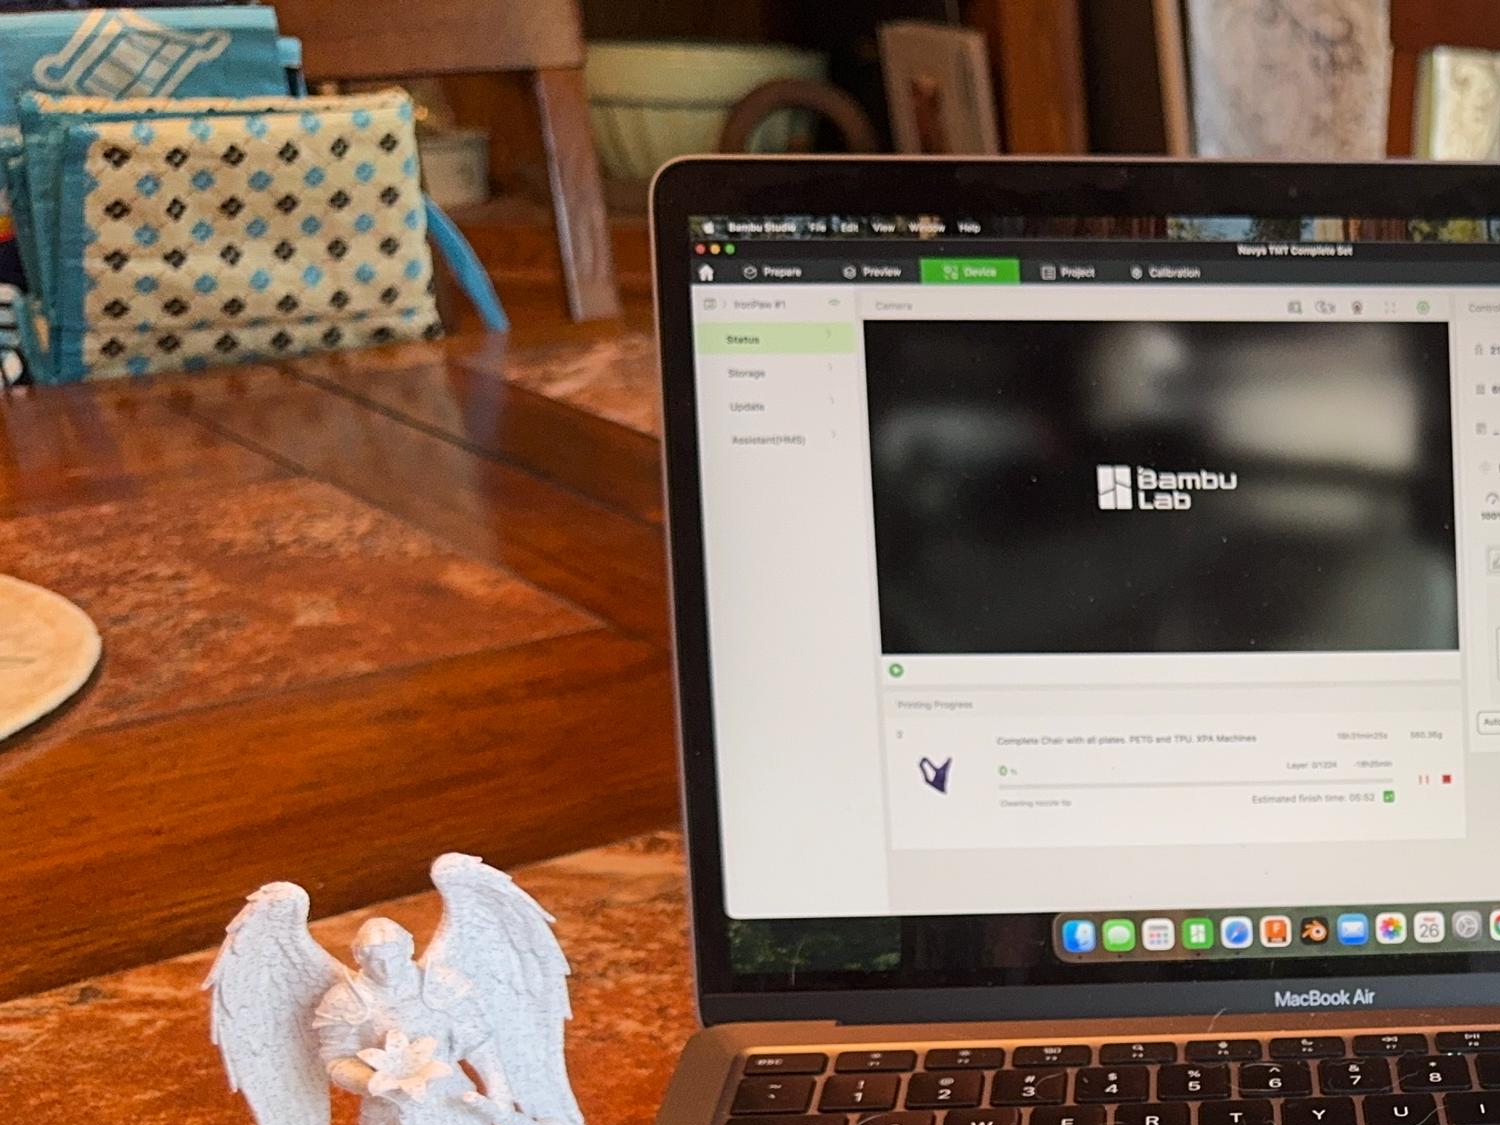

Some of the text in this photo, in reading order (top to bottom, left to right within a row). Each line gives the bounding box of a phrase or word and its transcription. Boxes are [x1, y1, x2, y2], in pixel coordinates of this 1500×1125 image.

[728, 222, 797, 233] Bambu Studio
[810, 222, 827, 233] File
[840, 222, 859, 233] Edit
[872, 222, 896, 233] View
[908, 222, 946, 233] Window
[957, 222, 982, 234] Help
[763, 266, 802, 278] Prepare
[863, 266, 902, 277] Preview
[963, 267, 997, 277] Device
[1060, 266, 1096, 278] Project
[1149, 267, 1201, 278] Calibration
[875, 302, 913, 310] Camera
[726, 336, 760, 344] Status
[728, 369, 766, 379] Storage
[730, 403, 765, 412] Update
[1137, 465, 1238, 490] Bambu
[1138, 490, 1192, 510] Lab
[898, 701, 973, 711] Printing Progress
[996, 737, 1039, 747] Complete
[1066, 736, 1085, 745] with
[1216, 734, 1257, 743] Machines
[1252, 794, 1297, 804] Estimated
[1299, 793, 1323, 803] finish
[1419, 923, 1440, 938] 26
[1274, 988, 1376, 1007] MacBook Air
[1269, 1078, 1281, 1087] 6
[1350, 1075, 1361, 1085] 7
[1429, 1073, 1441, 1082] 8
[1105, 1084, 1117, 1093] 4
[1189, 1081, 1200, 1091] 5
[855, 1092, 862, 1101] 1
[938, 1089, 951, 1099] 2
[1023, 1087, 1035, 1096] 3
[1394, 1107, 1408, 1116] U
[1480, 1104, 1485, 1113] I
[1230, 1113, 1242, 1123] T
[1312, 1110, 1325, 1120] Y
[1146, 1116, 1159, 1125] R
